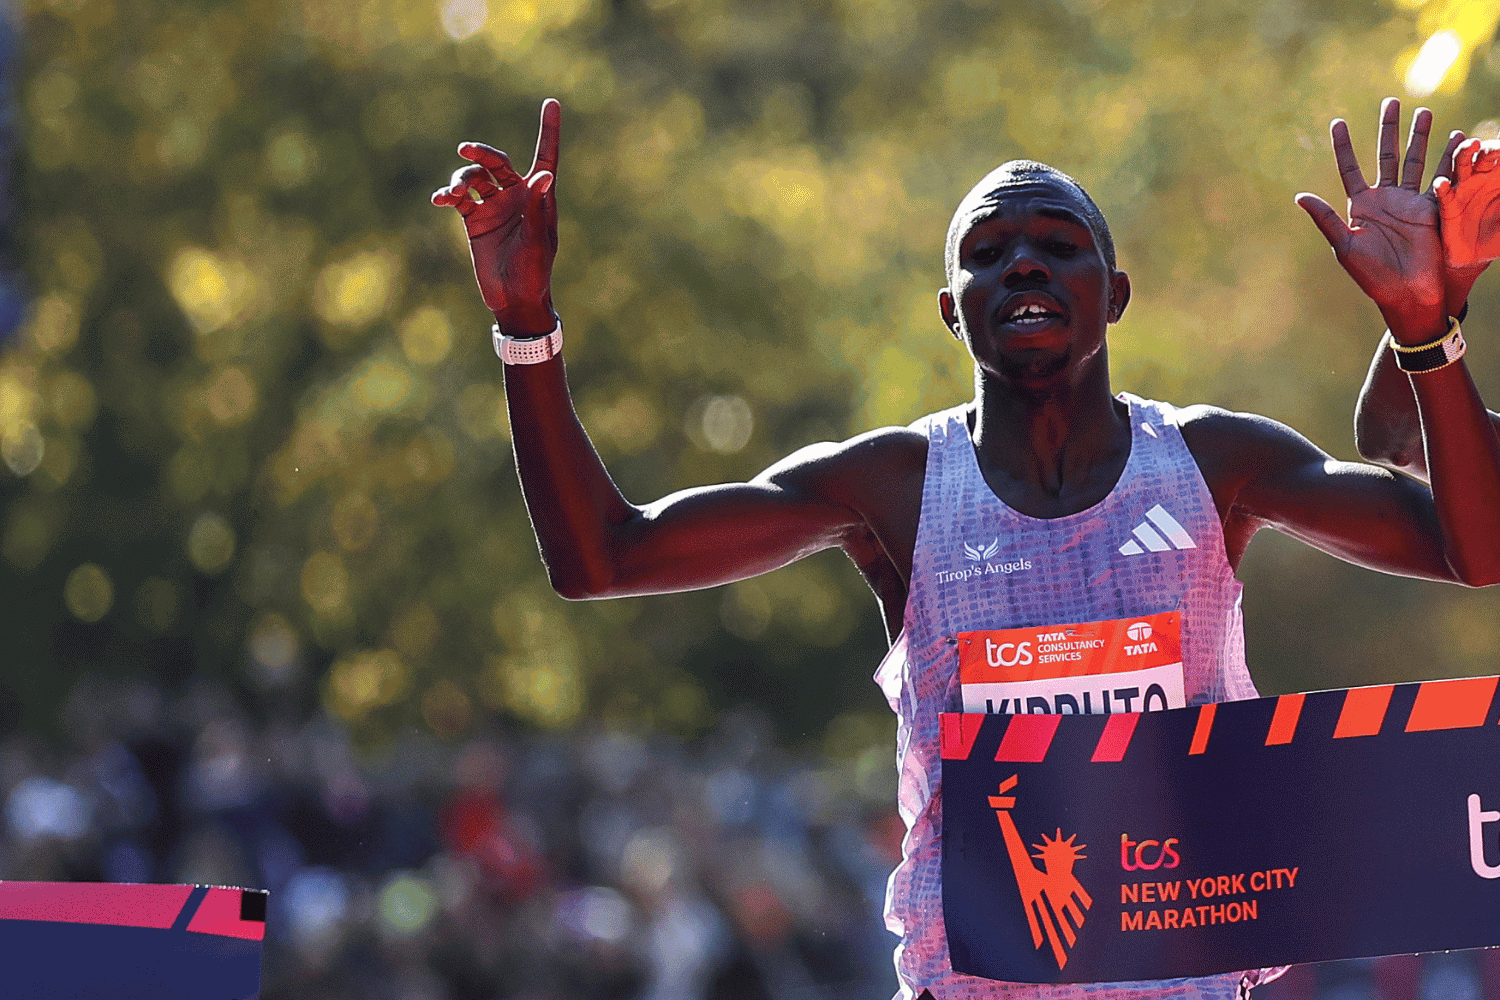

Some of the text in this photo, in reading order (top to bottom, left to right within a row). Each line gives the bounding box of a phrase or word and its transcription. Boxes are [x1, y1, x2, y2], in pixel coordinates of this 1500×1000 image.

[936, 558, 1033, 585] Tirop's Angels
[1036, 632, 1067, 643] TATA
[1037, 639, 1106, 654] CONSULTANCY
[1123, 642, 1158, 657] TATA
[1038, 652, 1082, 665] SERVICES
[1120, 867, 1299, 904] NEW YORK CITY
[1120, 900, 1258, 931] MARATHON
